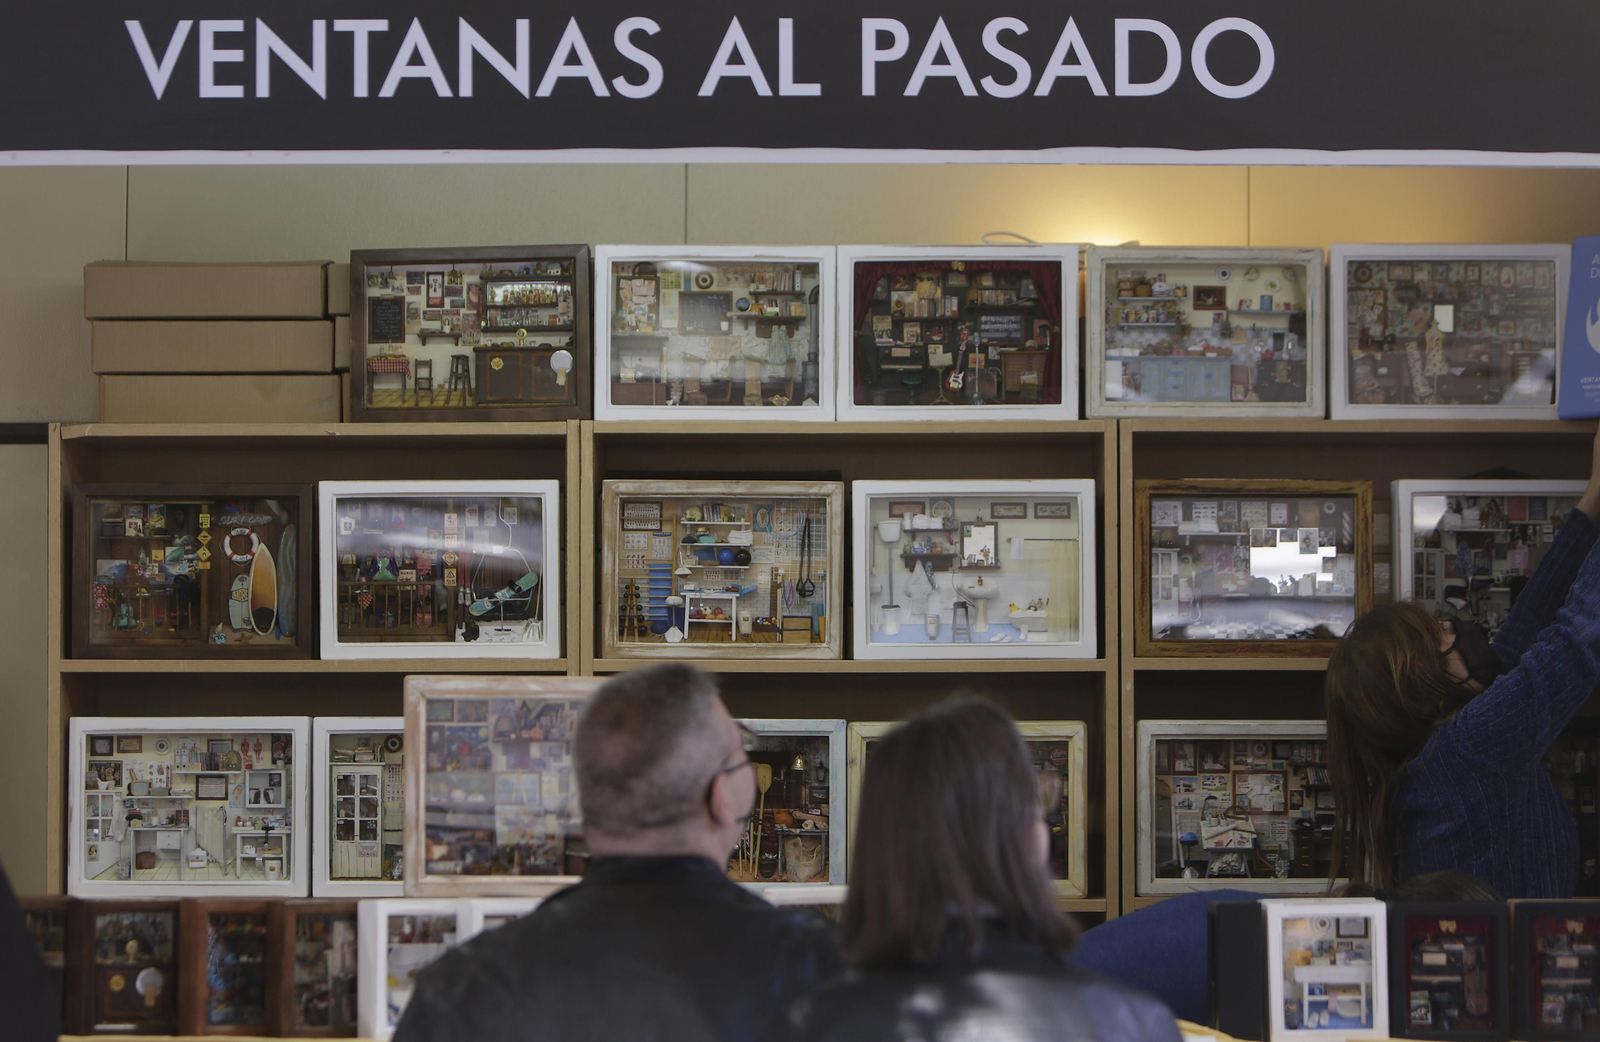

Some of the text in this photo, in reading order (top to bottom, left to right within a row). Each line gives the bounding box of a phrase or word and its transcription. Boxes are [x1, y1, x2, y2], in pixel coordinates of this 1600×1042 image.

[124, 15, 1276, 100] VENTANAS AL PASADO
[220, 515, 245, 525] SURF
[248, 515, 270, 524] CAMP
